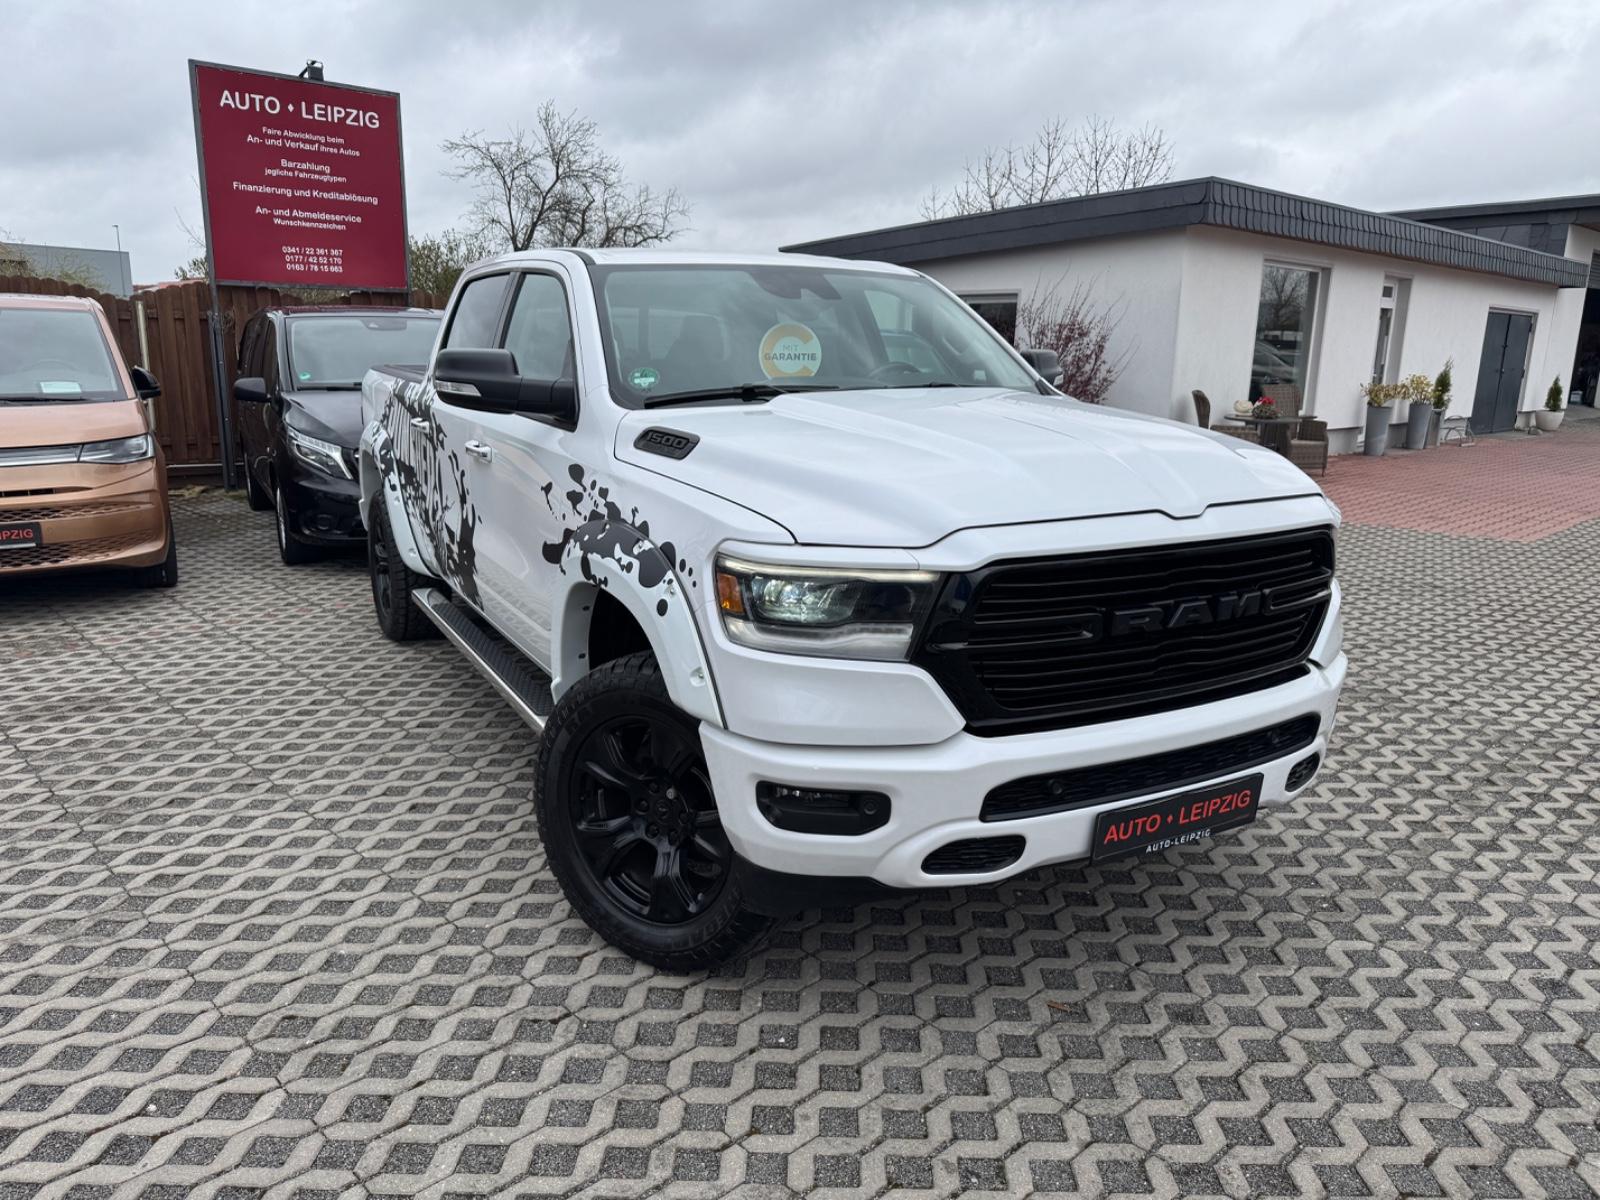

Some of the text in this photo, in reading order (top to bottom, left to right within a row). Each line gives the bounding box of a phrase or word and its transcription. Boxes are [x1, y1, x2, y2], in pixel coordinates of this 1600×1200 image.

[220, 90, 380, 129] AUTO LEIPZIG
[262, 126, 345, 145] Faire Abwicklung beim
[247, 134, 263, 144] An-
[265, 136, 282, 147] und
[284, 139, 320, 152] Verkauf
[339, 147, 361, 157] Autos
[280, 158, 331, 174] Barzahlung
[294, 170, 347, 183] Fahrzeugtypen
[232, 181, 379, 206] Finanzierung und Kreditablösung
[256, 205, 362, 224] An- und Abmeldeservice
[273, 217, 347, 231] Wunschkennzeichen
[285, 254, 303, 262] 0177
[763, 352, 817, 361] GARANTIE
[782, 343, 800, 352] MIT
[646, 431, 687, 449] 1500
[1111, 591, 1261, 637] RAM
[1103, 790, 1251, 845] AUTO LEIPZIG
[1145, 828, 1211, 853] AUTO-LEIPZIG
